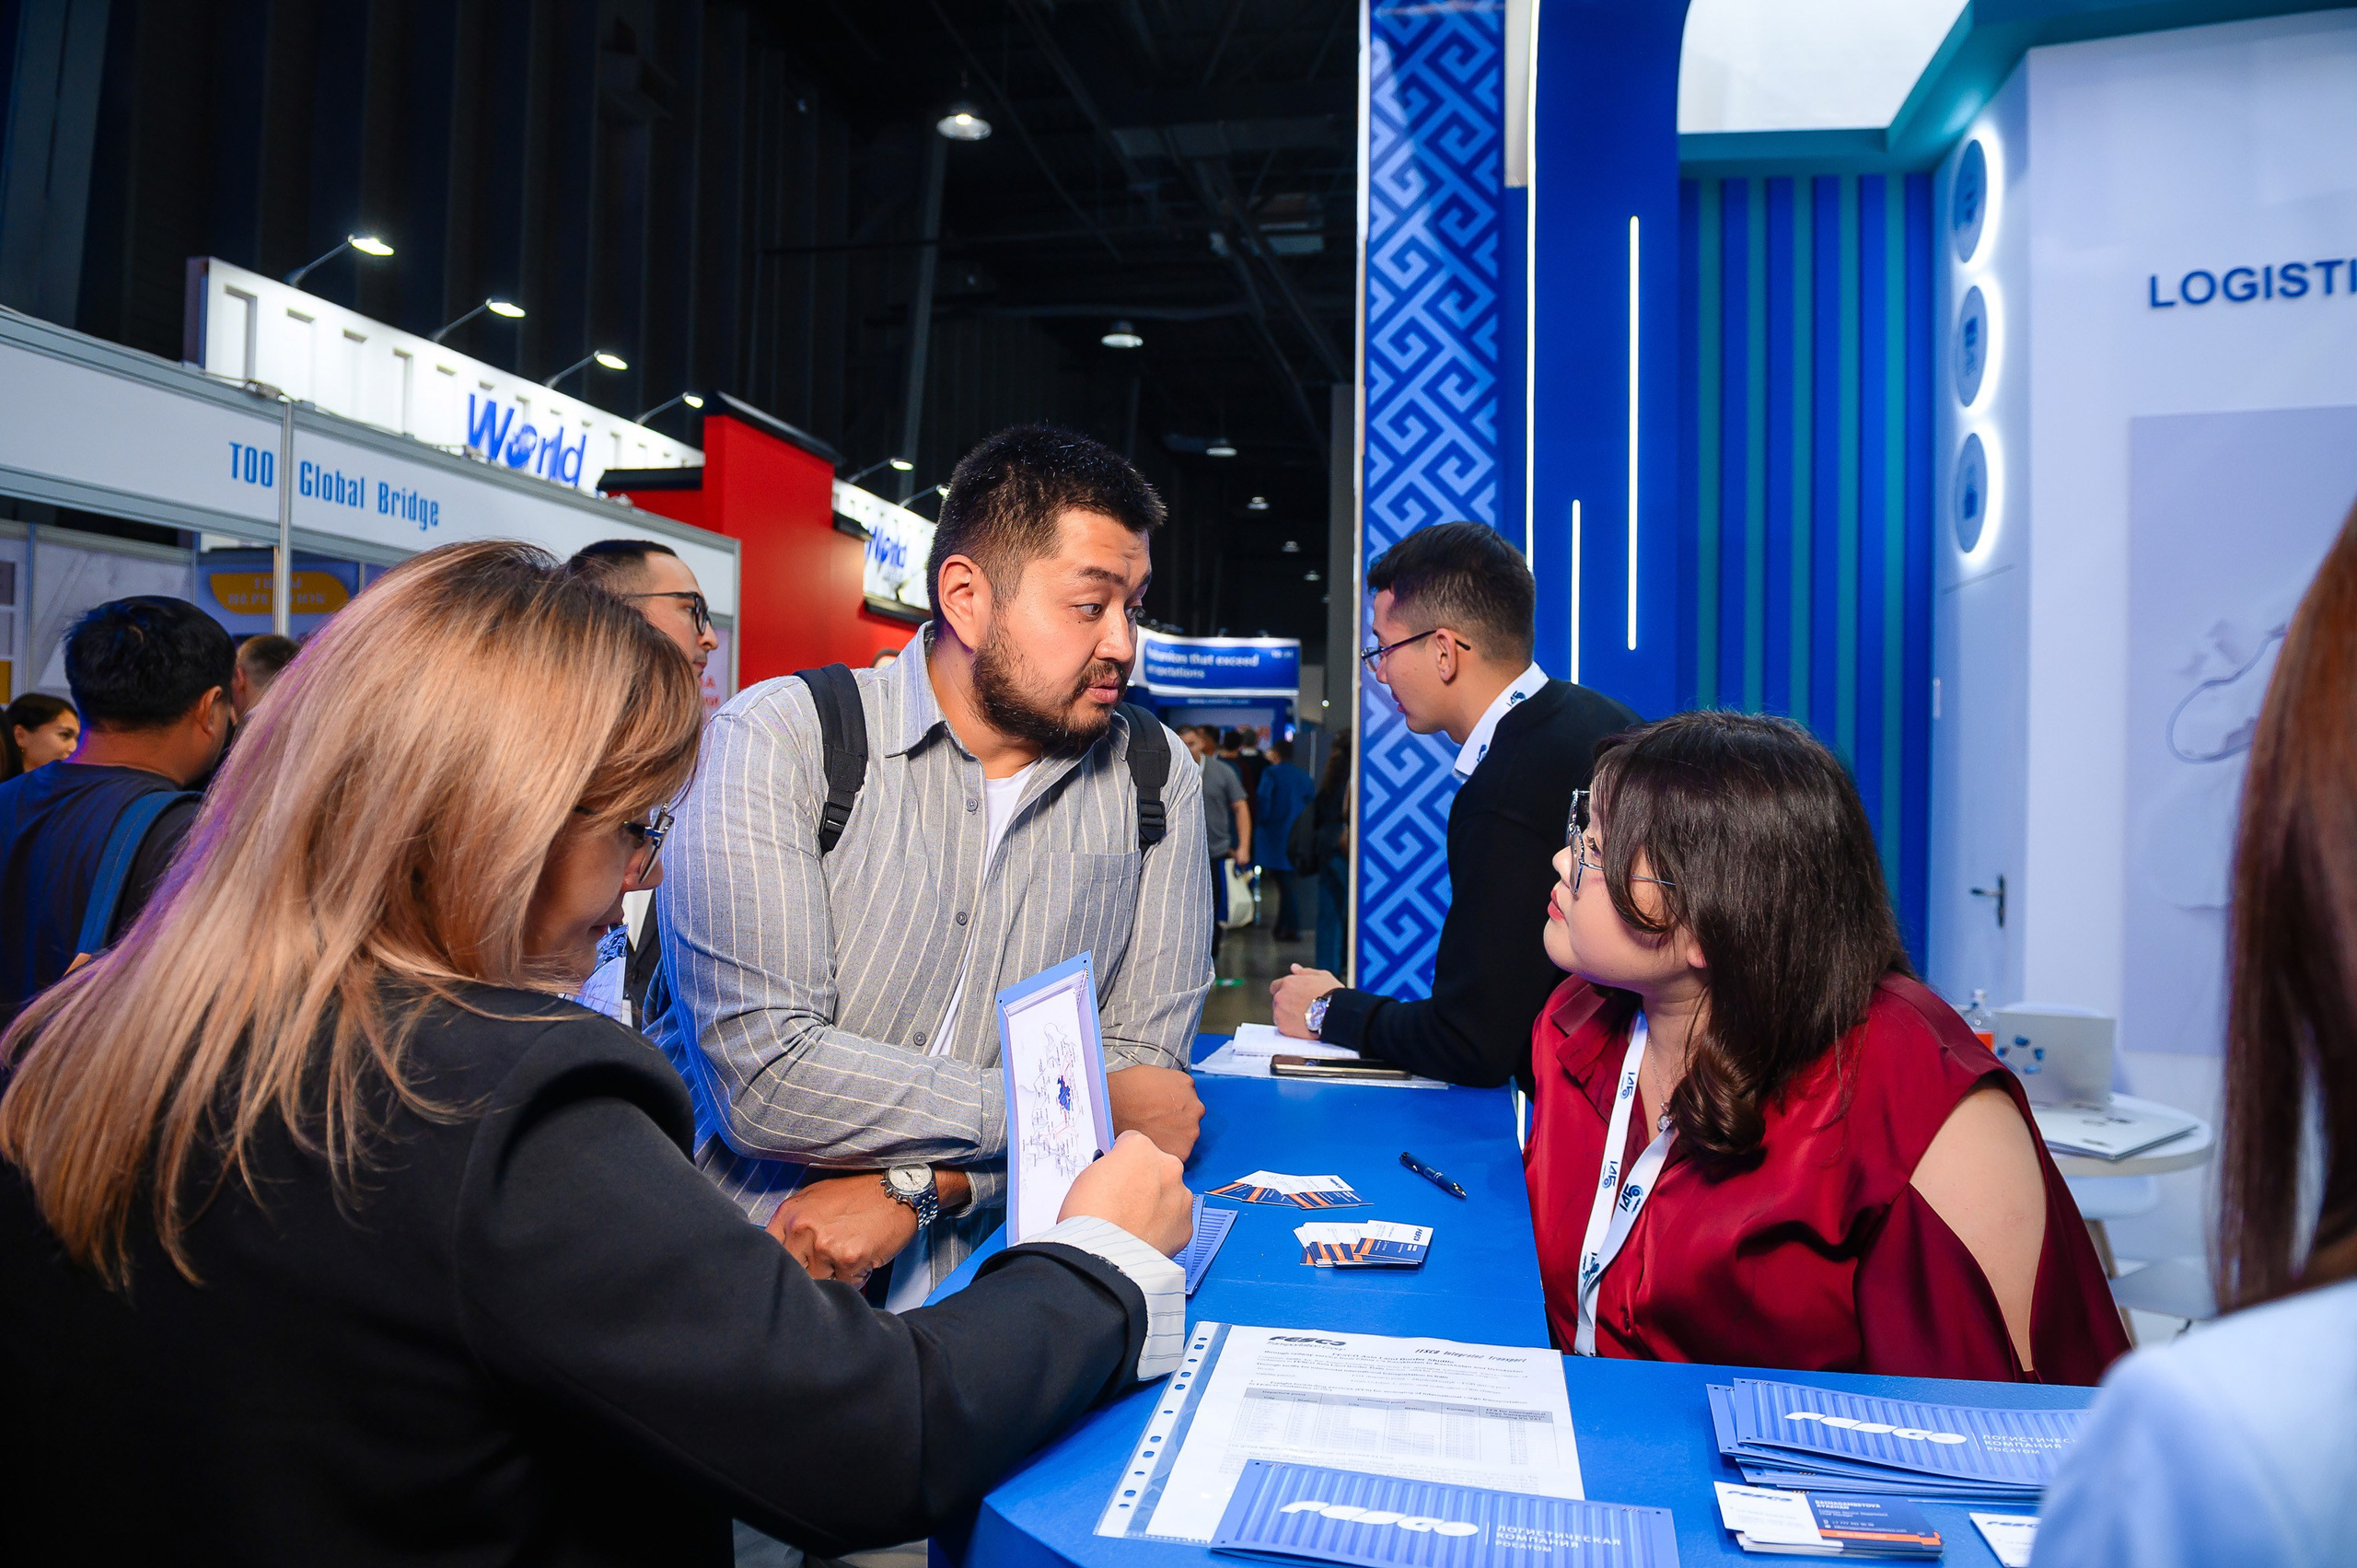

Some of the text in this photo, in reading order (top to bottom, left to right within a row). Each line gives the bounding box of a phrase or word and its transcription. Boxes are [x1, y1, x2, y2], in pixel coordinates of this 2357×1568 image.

[468, 393, 586, 487] World
[299, 461, 365, 509] Global
[377, 481, 439, 532] Bridge
[1983, 1439, 2061, 1449] КОМПАНИЯ
[1986, 1446, 2040, 1455] РОСАТОМ
[1495, 1531, 1579, 1549] КОМПАНИЯ
[1496, 1524, 1620, 1546] ЛОГИСТИЧЕСКАЯ
[1494, 1539, 1552, 1552] РОСАТОМ
